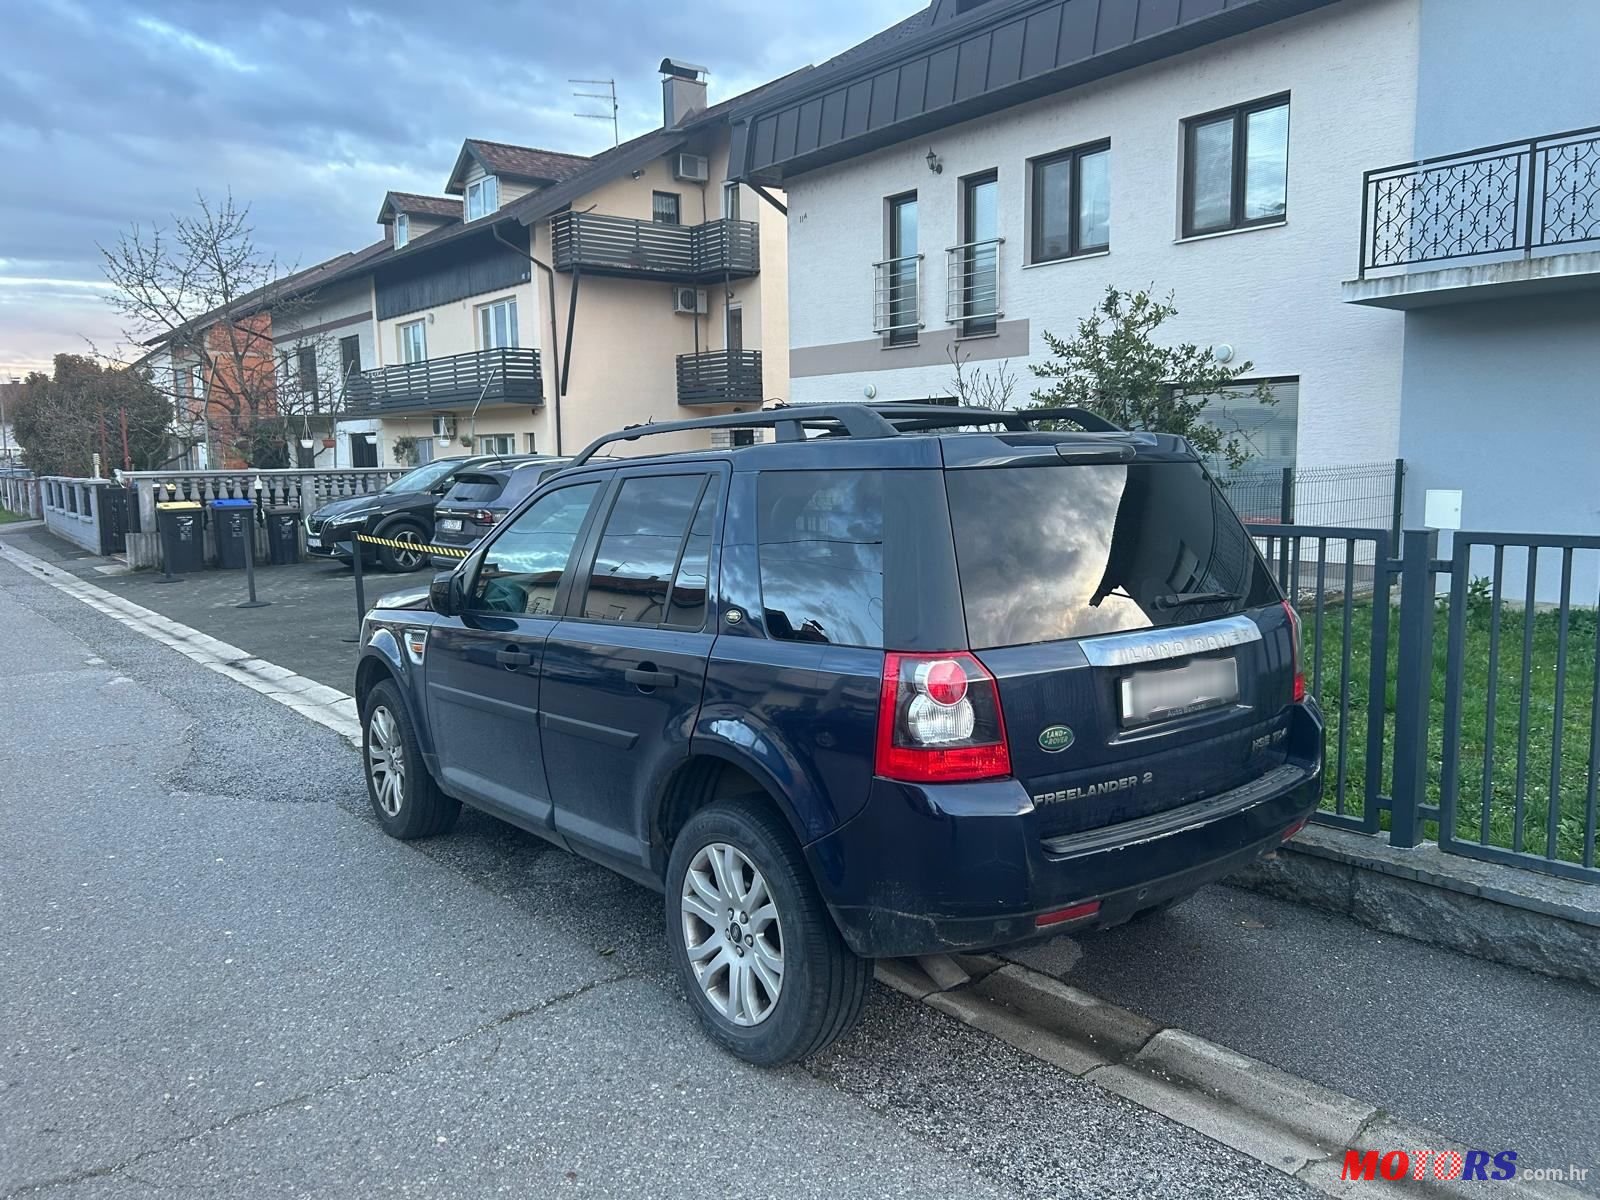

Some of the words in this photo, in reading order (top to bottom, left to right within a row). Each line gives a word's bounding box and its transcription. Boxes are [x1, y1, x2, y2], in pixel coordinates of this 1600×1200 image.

[1129, 641, 1186, 661] LAND
[1033, 775, 1138, 807] FREELANDER
[1142, 771, 1154, 784] 2
